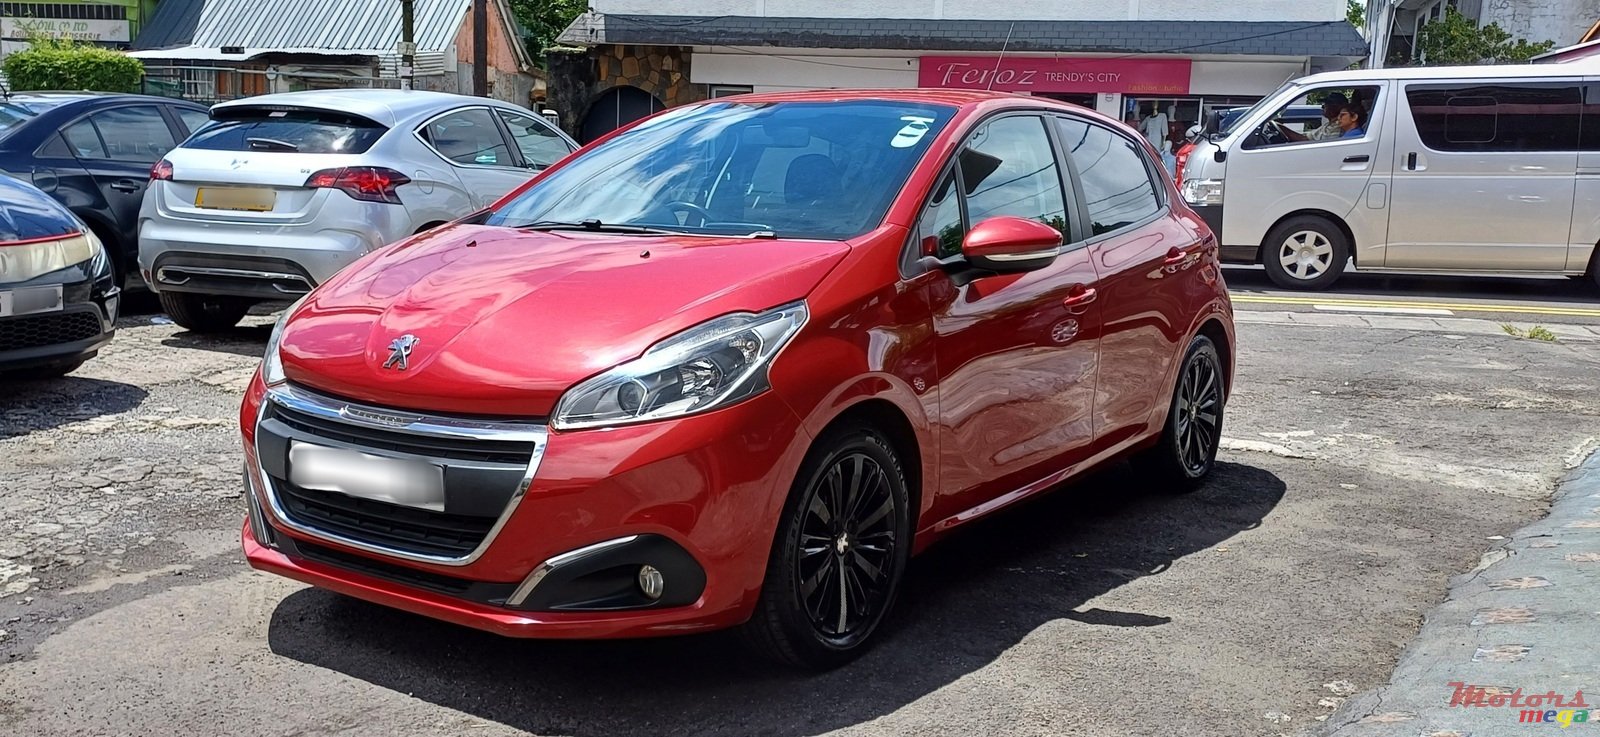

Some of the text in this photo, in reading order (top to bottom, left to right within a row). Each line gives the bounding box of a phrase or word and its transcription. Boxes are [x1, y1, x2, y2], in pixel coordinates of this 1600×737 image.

[937, 62, 1121, 86] Feroz TRENDY'S CITY
